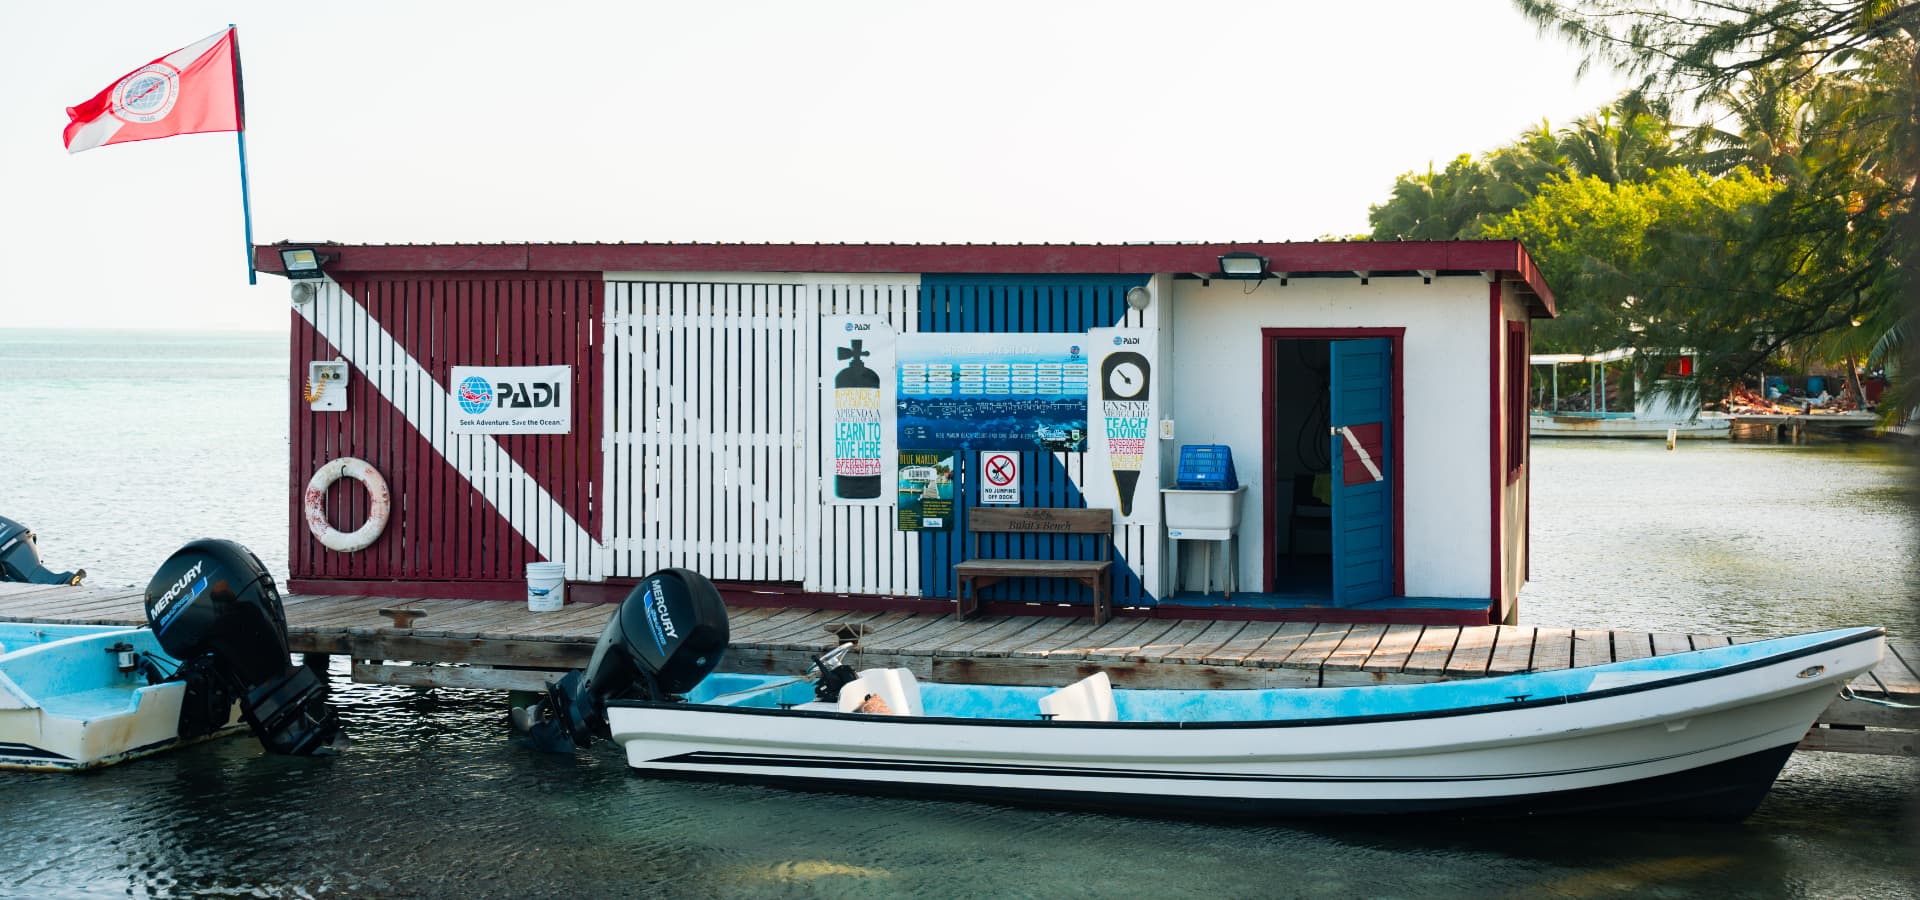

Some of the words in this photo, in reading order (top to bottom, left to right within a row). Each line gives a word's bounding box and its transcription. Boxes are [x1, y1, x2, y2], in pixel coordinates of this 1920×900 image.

[497, 382, 560, 408] PADI
[835, 422, 866, 441] LEARN
[867, 422, 881, 441] TO
[1104, 417, 1149, 428] TEACH
[1106, 428, 1147, 439] DIVING
[835, 441, 856, 459] DIVE
[857, 441, 881, 459] HERE
[899, 454, 914, 465] BLUE
[915, 454, 939, 465] MARLIN
[1042, 520, 1072, 530] Bench
[150, 560, 203, 621] MERCURY
[651, 579, 679, 639] MERCURY
